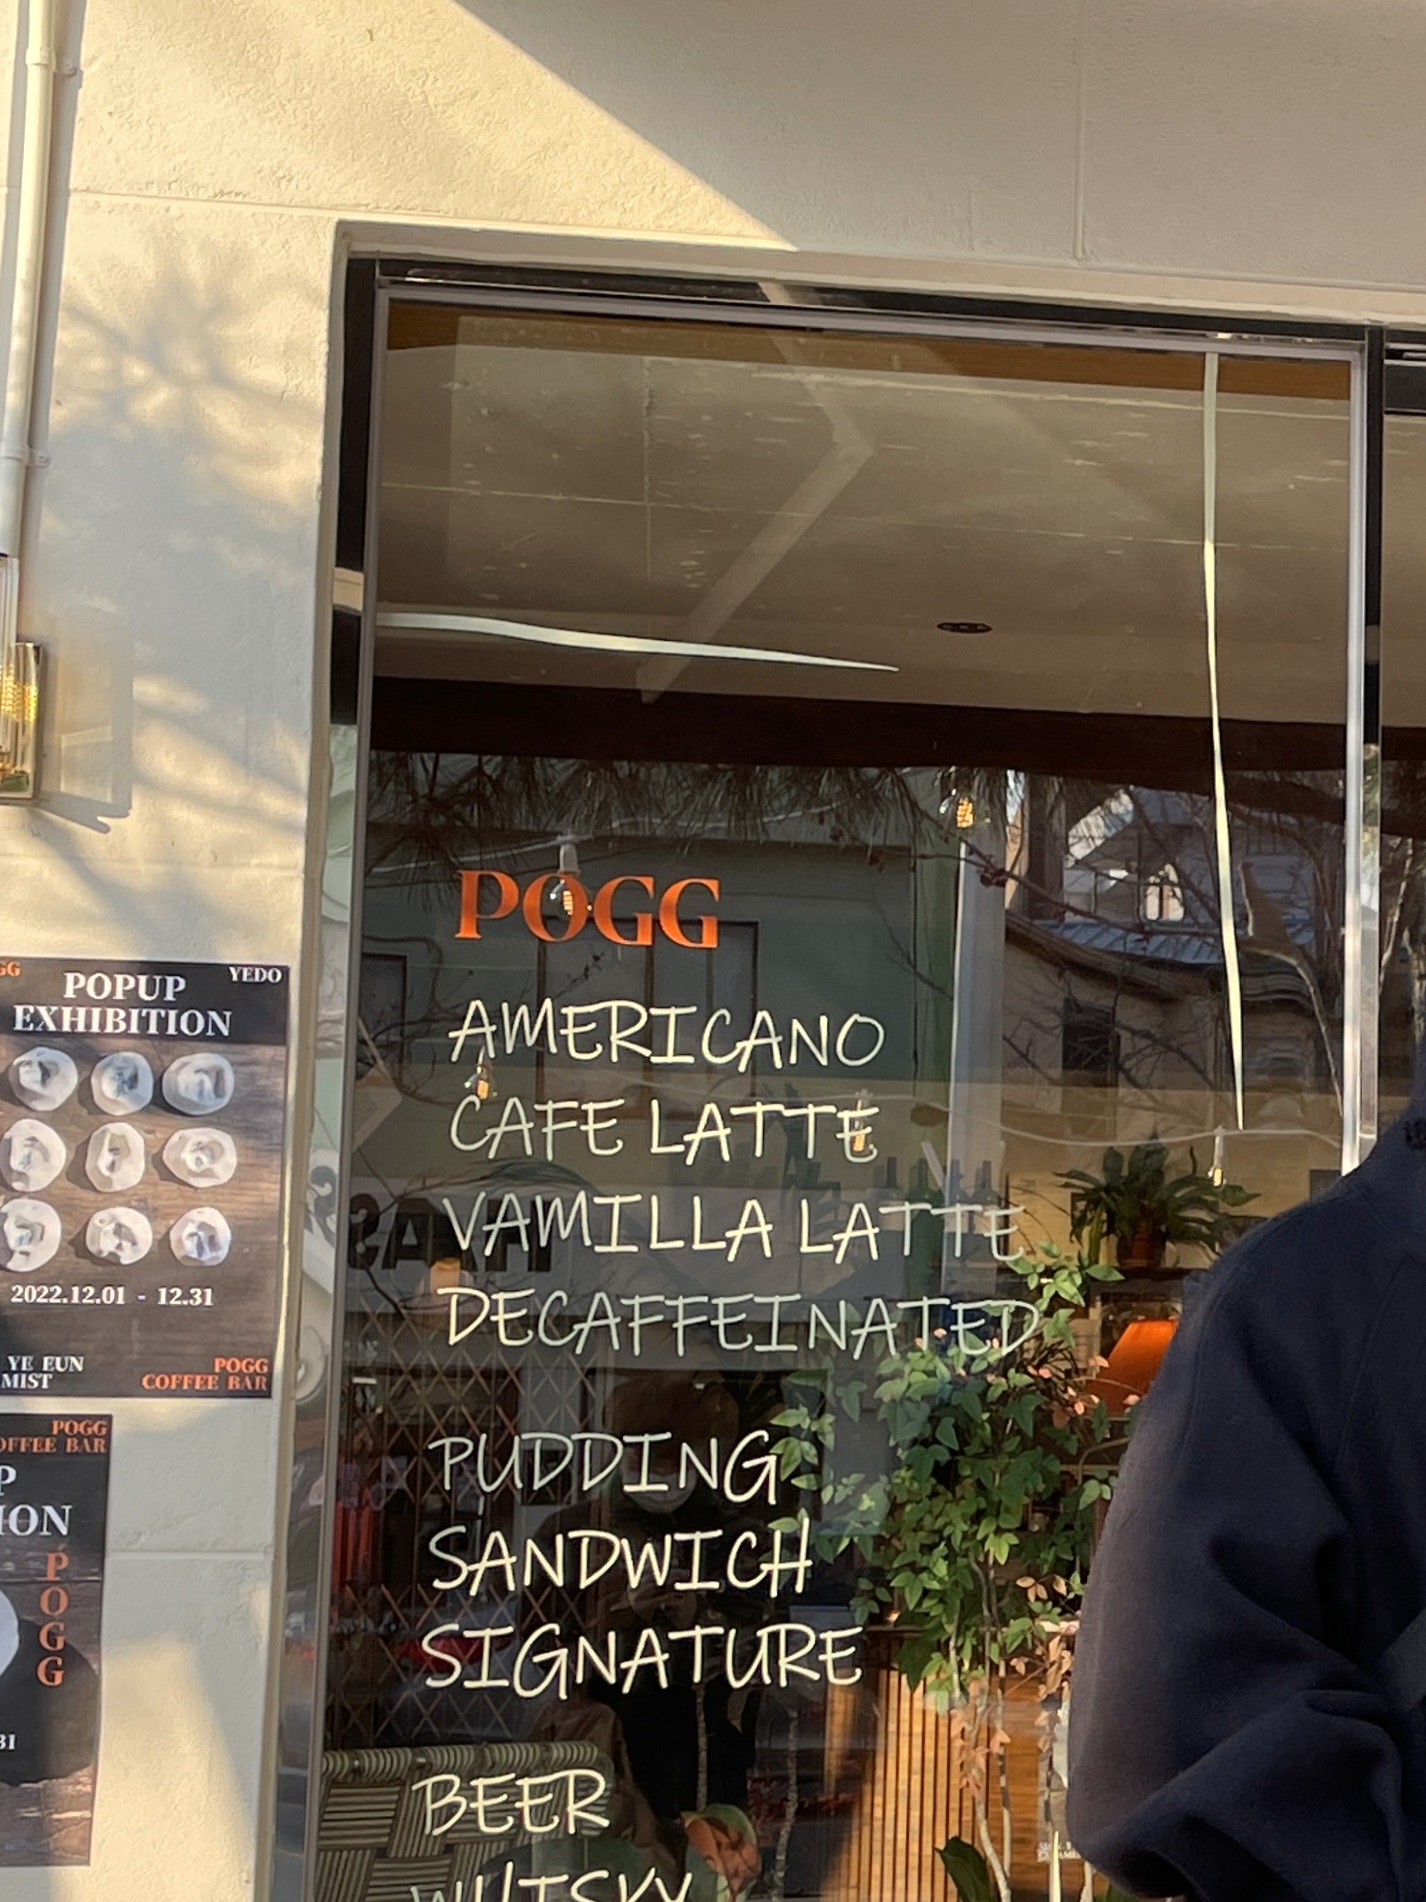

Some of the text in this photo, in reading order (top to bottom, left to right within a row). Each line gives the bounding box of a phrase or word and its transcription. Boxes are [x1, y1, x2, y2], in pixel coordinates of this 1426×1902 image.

[455, 870, 720, 949] POGG
[63, 972, 187, 1001] POPUP
[228, 966, 282, 983] YEDO
[13, 1004, 233, 1037] EXHIBITION
[449, 998, 885, 1072] AMERICANO
[449, 1095, 879, 1165] CAFE LATTE
[442, 1190, 1026, 1264] VAMILLA LATTE
[10, 1284, 126, 1306] 2022.12.01
[157, 1286, 214, 1306] 12.31
[436, 1287, 1039, 1360] DECAFFEINATED
[7, 1355, 85, 1372] YE EUN
[141, 1374, 268, 1391] COFFEE BAR
[214, 1357, 269, 1375] POGG
[52, 1420, 108, 1436] POGG
[66, 1437, 107, 1454] BAR
[428, 1429, 778, 1505] PUDDING
[428, 1517, 812, 1598] SANDWICH
[420, 1622, 864, 1699] SIGNATURE
[410, 1769, 610, 1836] BEER
